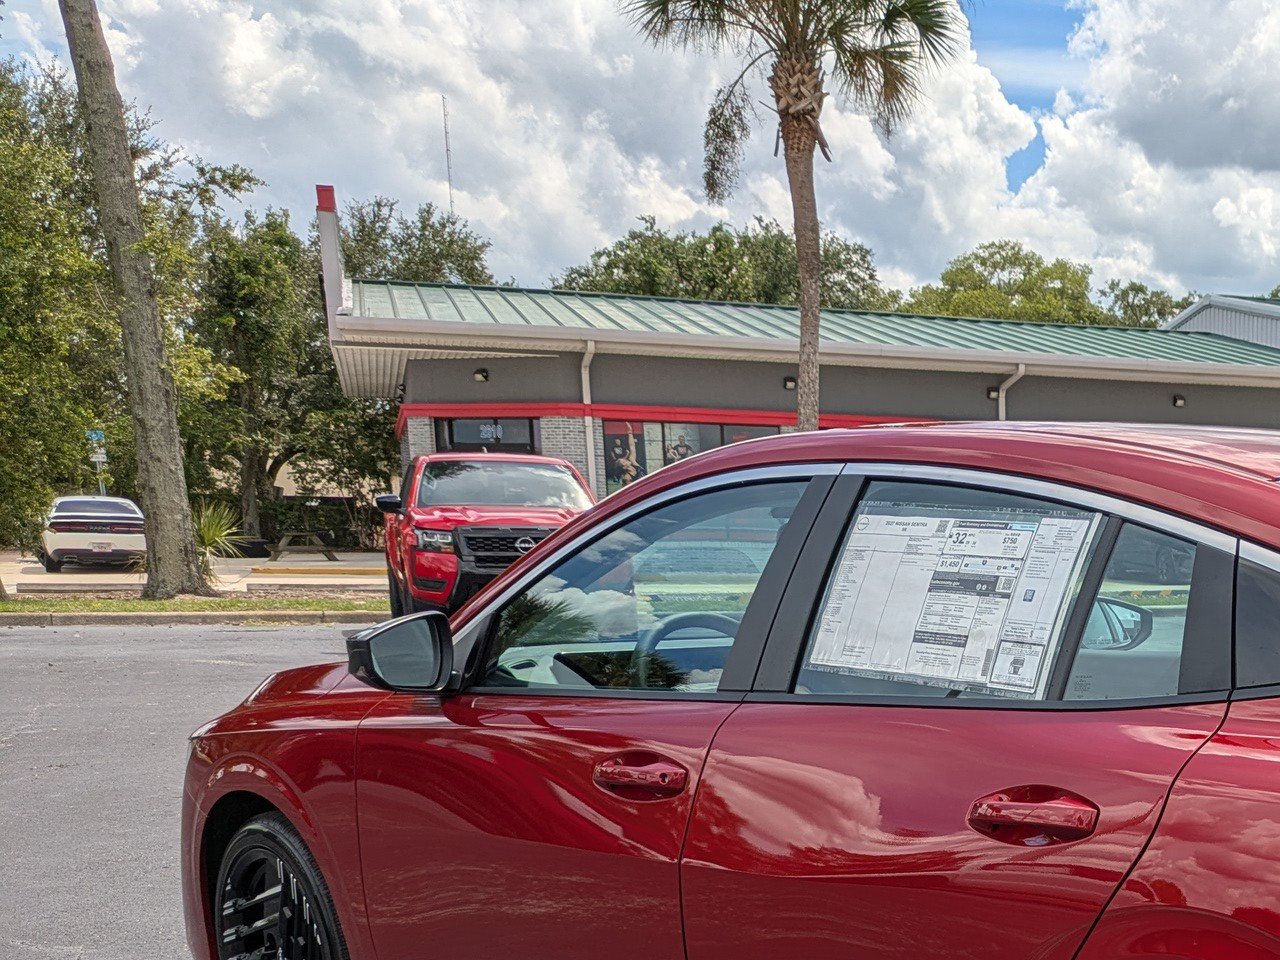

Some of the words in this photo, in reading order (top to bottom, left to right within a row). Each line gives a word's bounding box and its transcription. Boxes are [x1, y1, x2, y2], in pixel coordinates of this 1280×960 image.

[952, 532, 968, 544] 32
[1002, 537, 1018, 545] $750
[940, 560, 960, 568] $1,450
